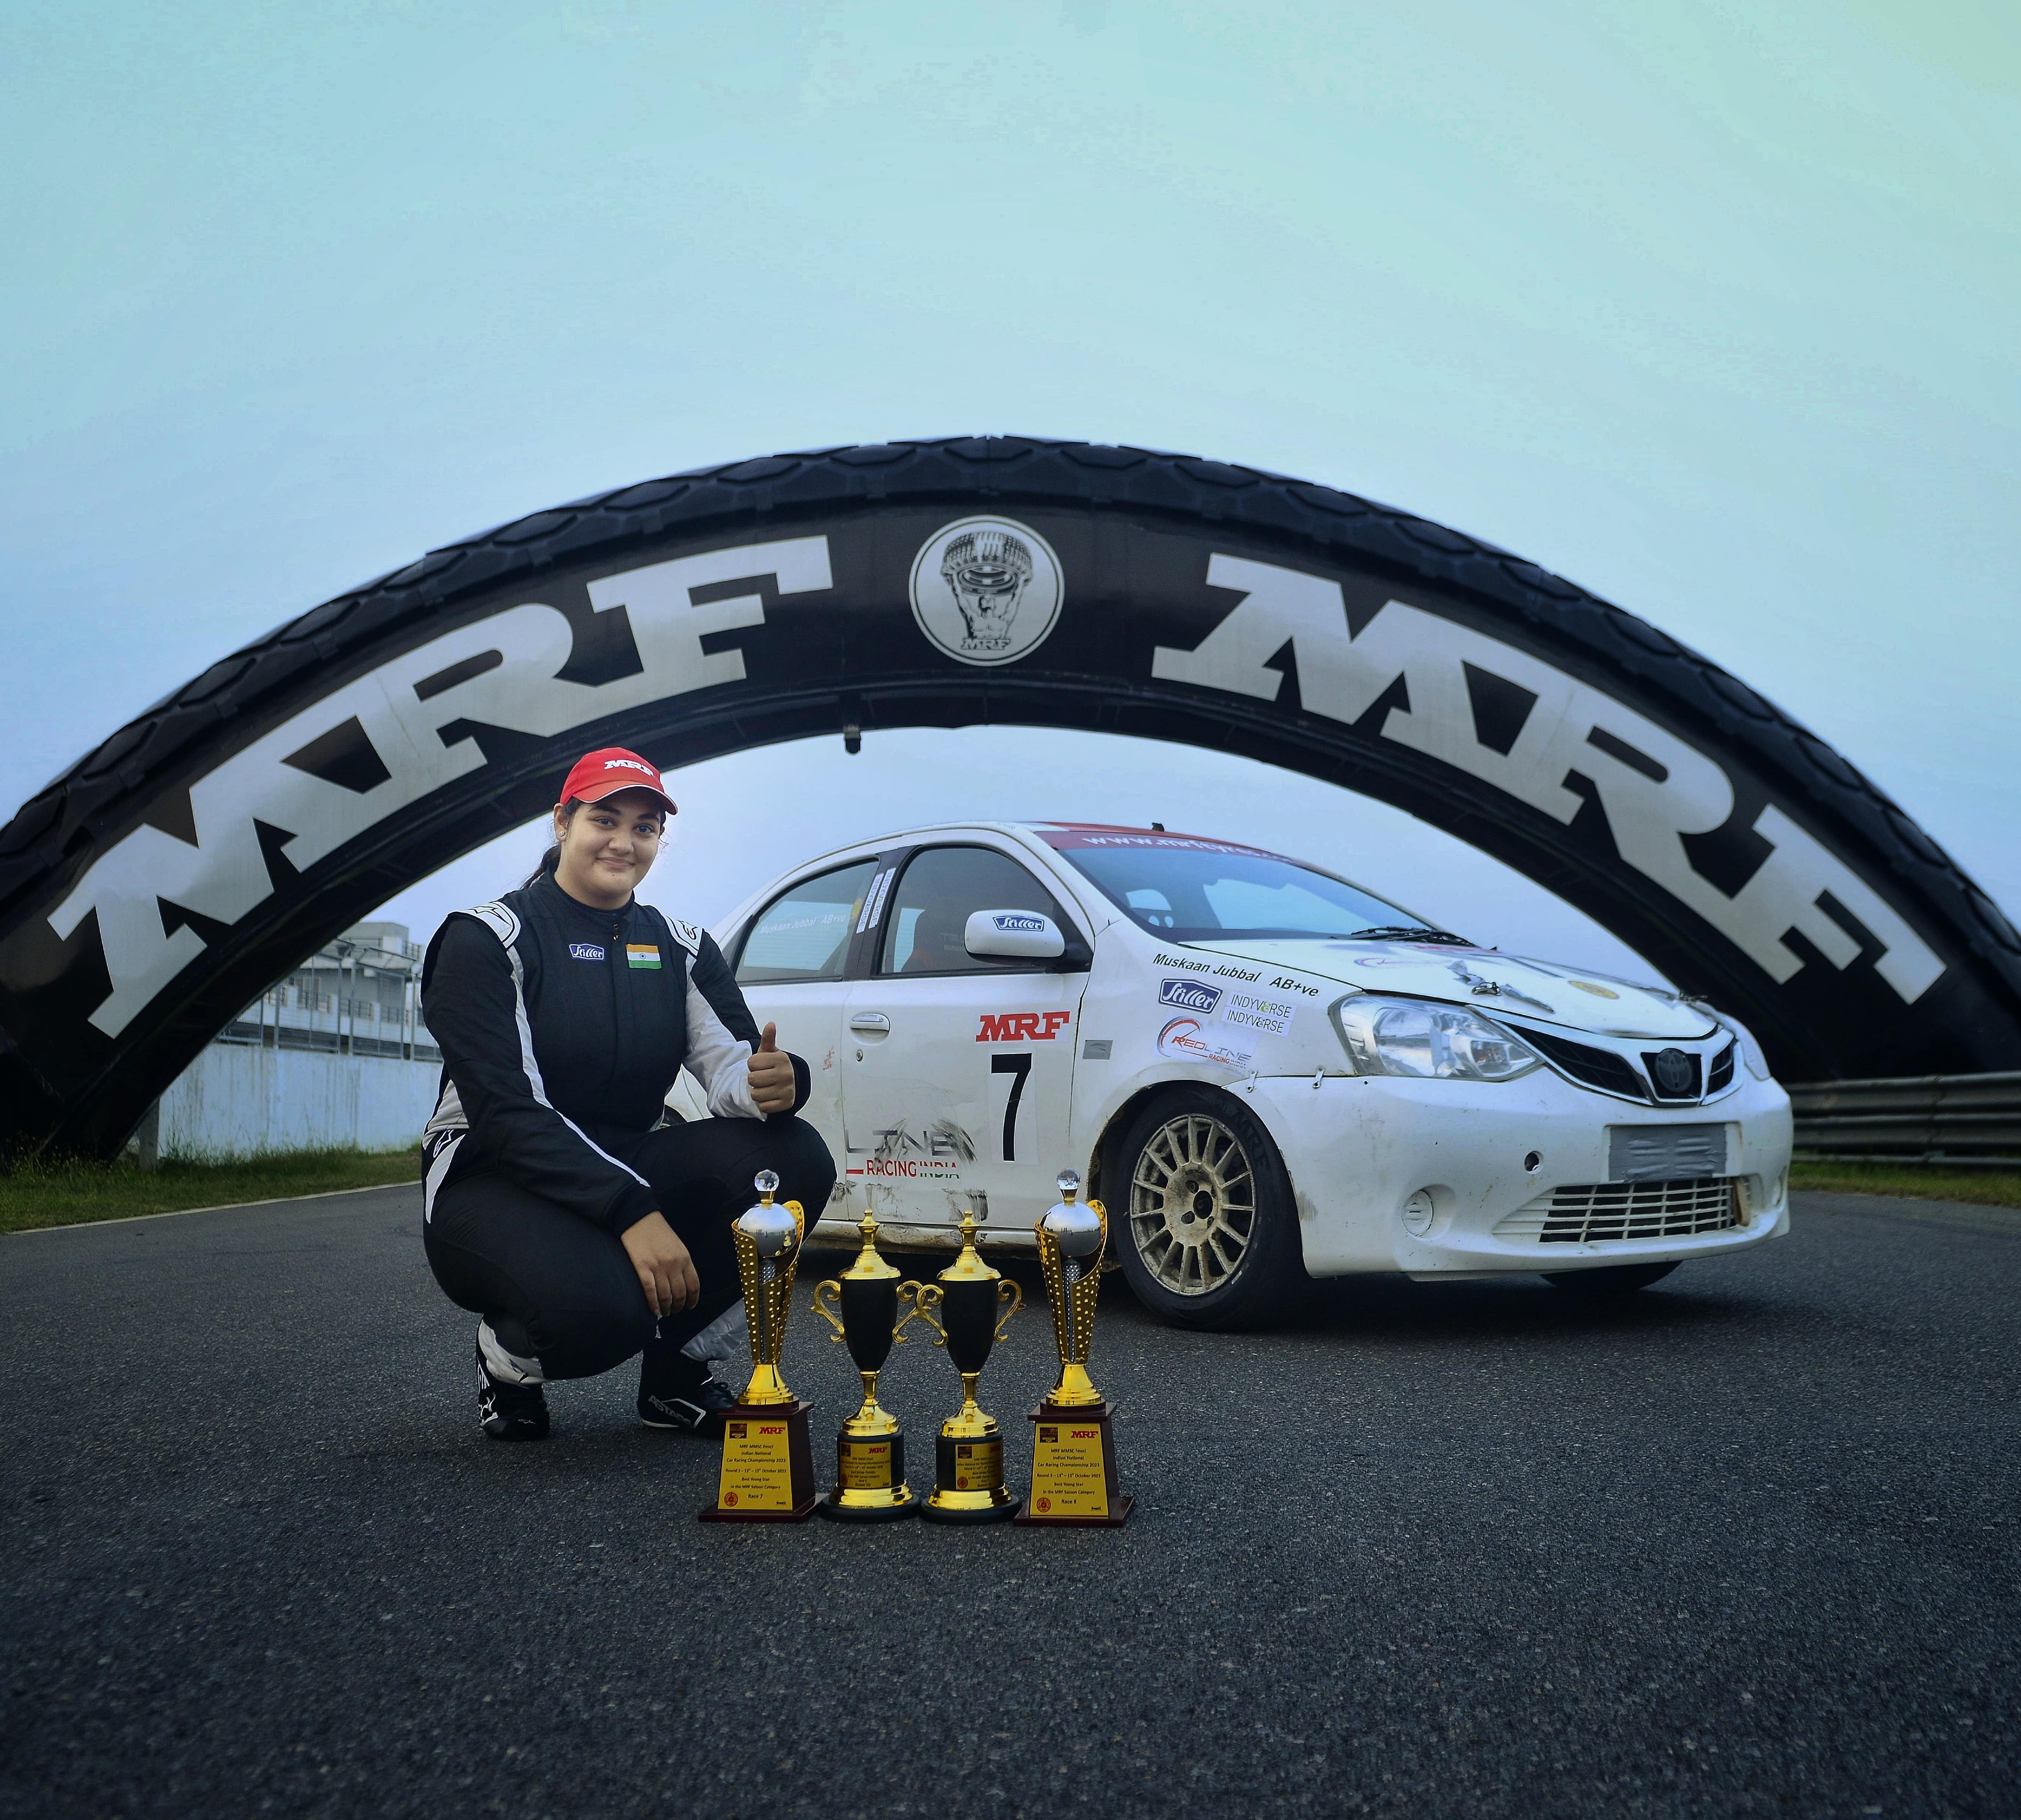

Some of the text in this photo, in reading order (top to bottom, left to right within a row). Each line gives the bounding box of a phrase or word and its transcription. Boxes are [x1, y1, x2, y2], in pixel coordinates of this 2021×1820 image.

[960, 638, 1011, 650] MRF
[604, 760, 654, 776] MRF
[1151, 553, 1946, 1005] MRF
[47, 535, 833, 1040] MRF
[1153, 953, 1319, 997] Muskaan Jubbal AB+ve
[1163, 983, 1214, 1008] Stiller
[975, 1011, 1070, 1042] MRF
[1208, 1053, 1230, 1064] RACING
[991, 1053, 1032, 1162] 7
[866, 1159, 917, 1177] RACING
